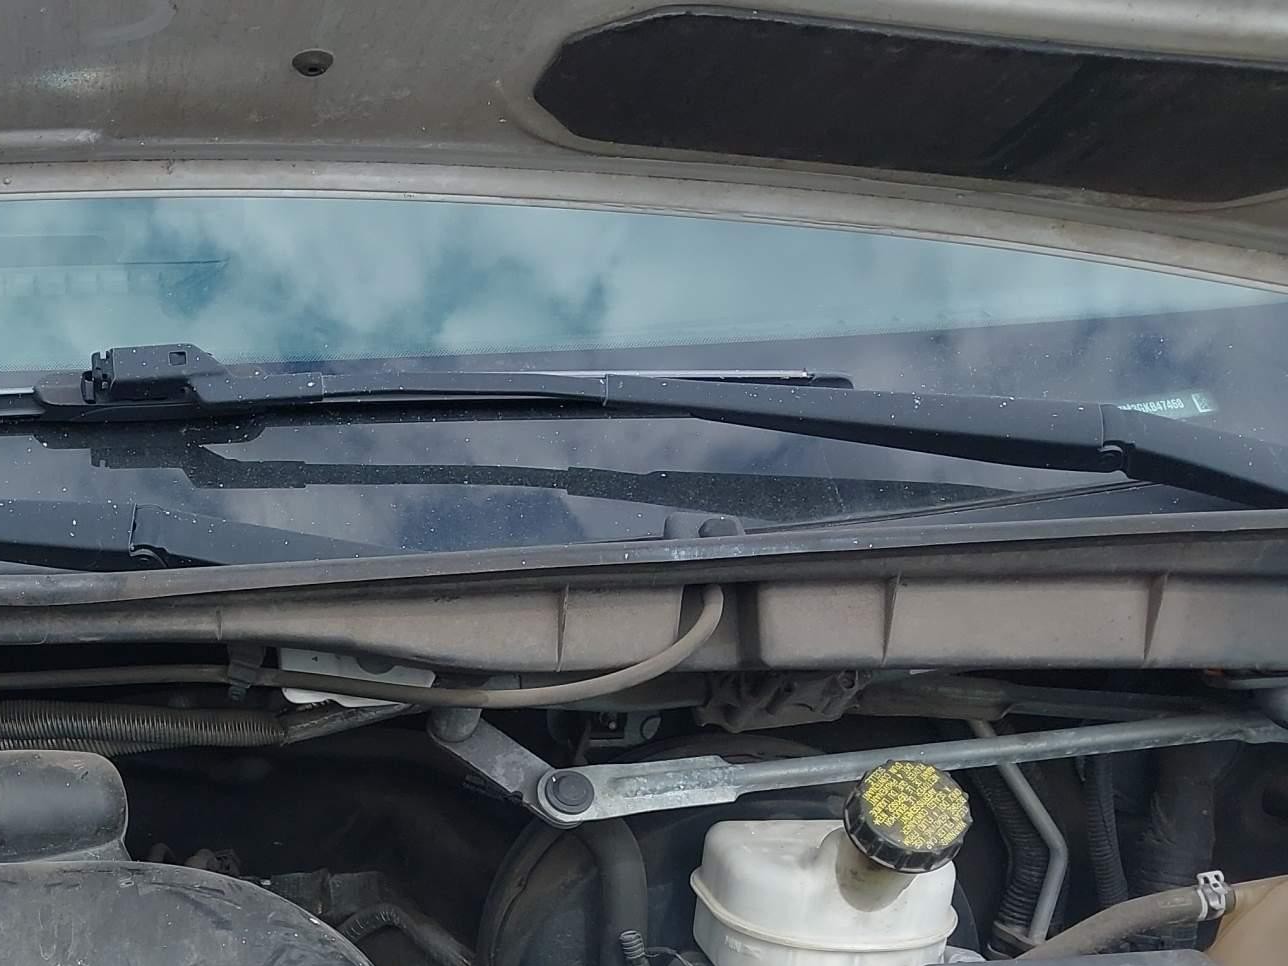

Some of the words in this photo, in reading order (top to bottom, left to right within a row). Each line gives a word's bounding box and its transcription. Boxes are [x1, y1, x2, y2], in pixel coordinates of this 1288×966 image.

[900, 761, 914, 775] DOT
[925, 790, 946, 810] SEALED
[936, 799, 949, 812] DOT
[883, 802, 909, 828] BOUCHON
[901, 829, 919, 846] FROM
[911, 835, 925, 850] USE
[923, 835, 938, 849] CAP
